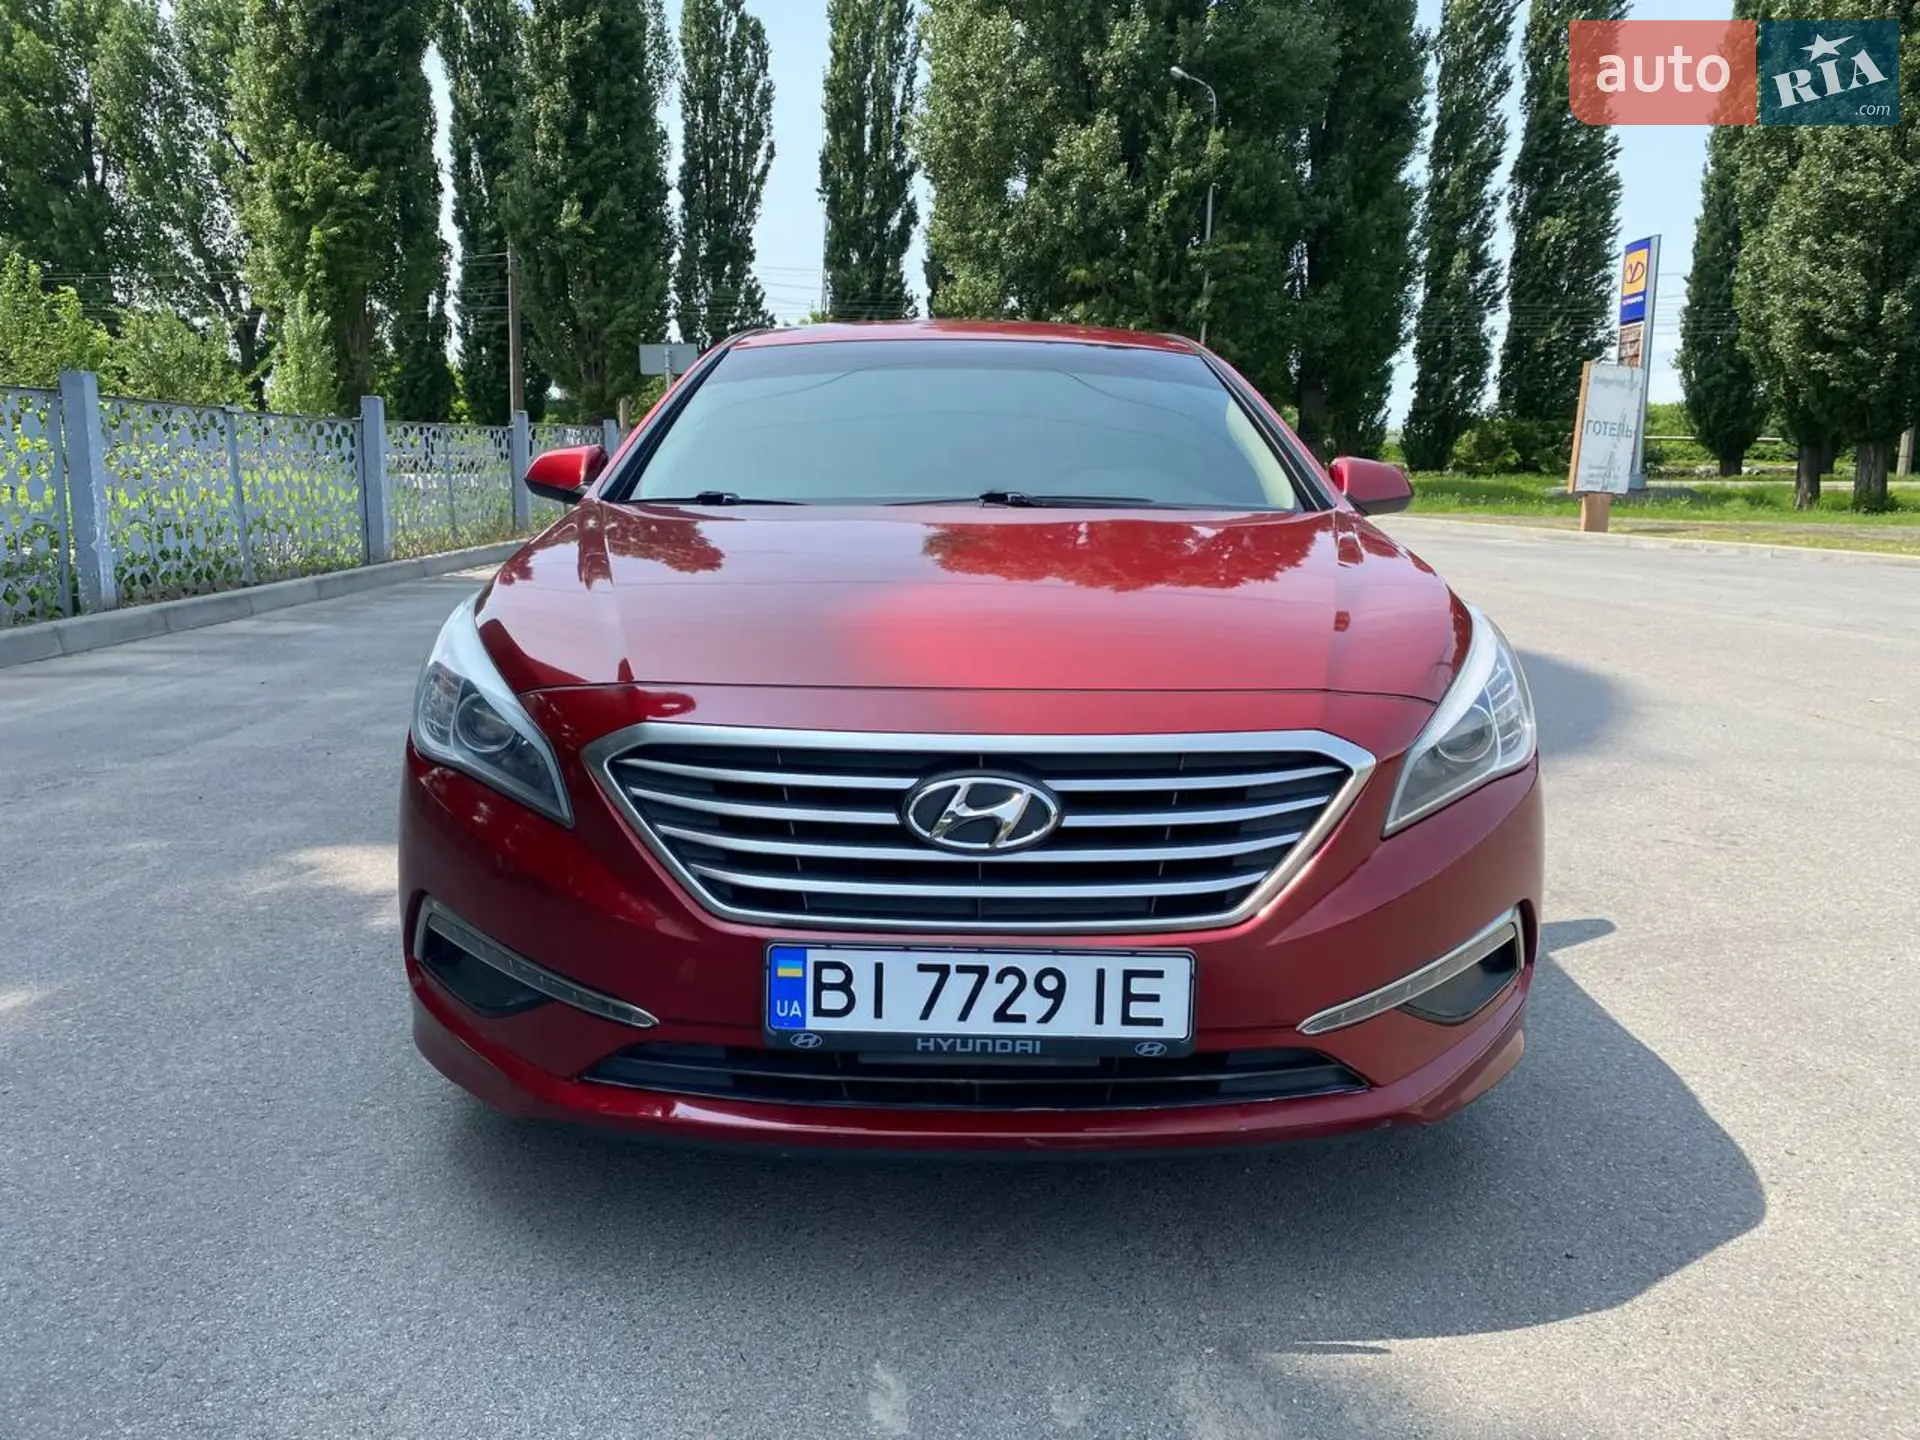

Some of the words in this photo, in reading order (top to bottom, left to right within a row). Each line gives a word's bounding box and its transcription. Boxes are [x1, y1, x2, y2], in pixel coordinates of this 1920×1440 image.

[1585, 419, 1633, 438] ГОТЕЛЬ
[812, 961, 884, 1019] BI
[916, 963, 1067, 1024] 7729
[1094, 968, 1165, 1027] IE
[776, 1000, 803, 1018] UA
[916, 1038, 1041, 1055] HYUNDAI
